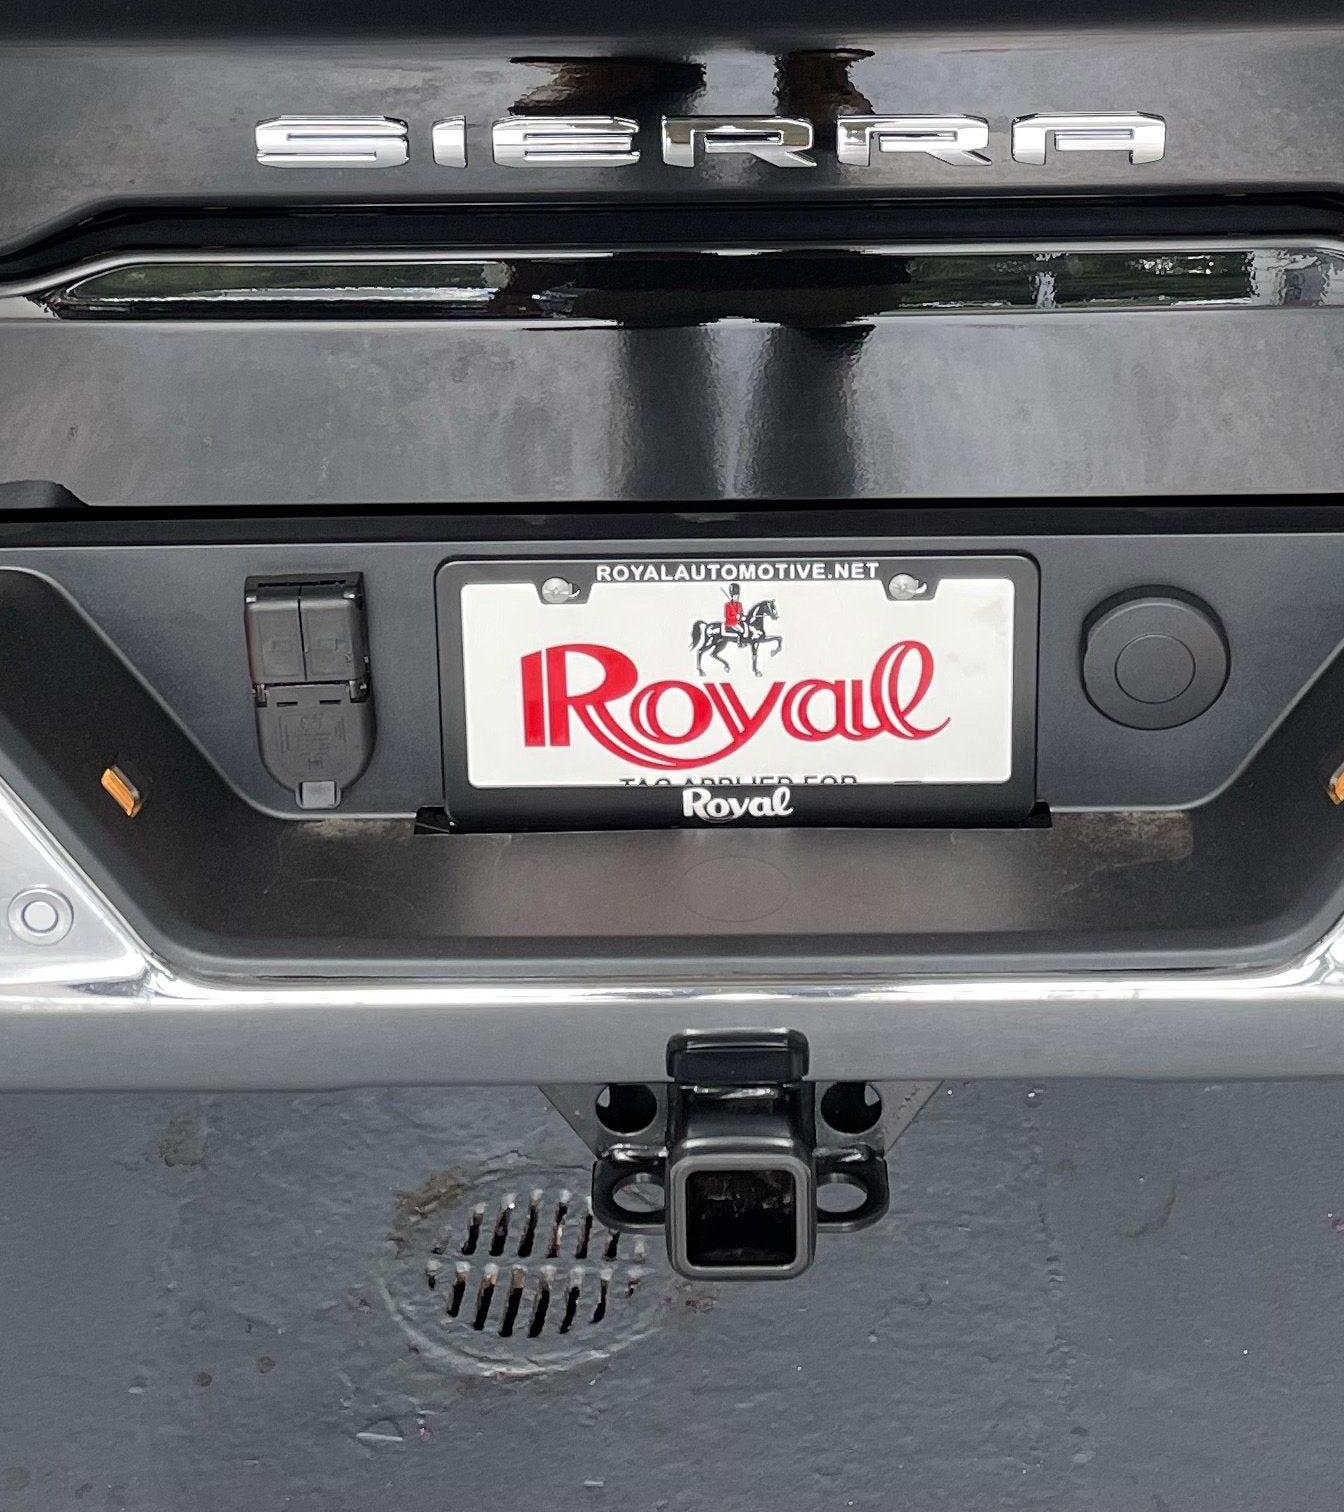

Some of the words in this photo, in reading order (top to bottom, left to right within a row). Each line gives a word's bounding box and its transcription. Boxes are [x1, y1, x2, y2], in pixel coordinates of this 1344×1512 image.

[254, 113, 1167, 168] SIERRA
[596, 562, 879, 582] ROYALAUTOMOTIVE.NET
[520, 639, 952, 769] Royal
[682, 786, 794, 822] Royal
